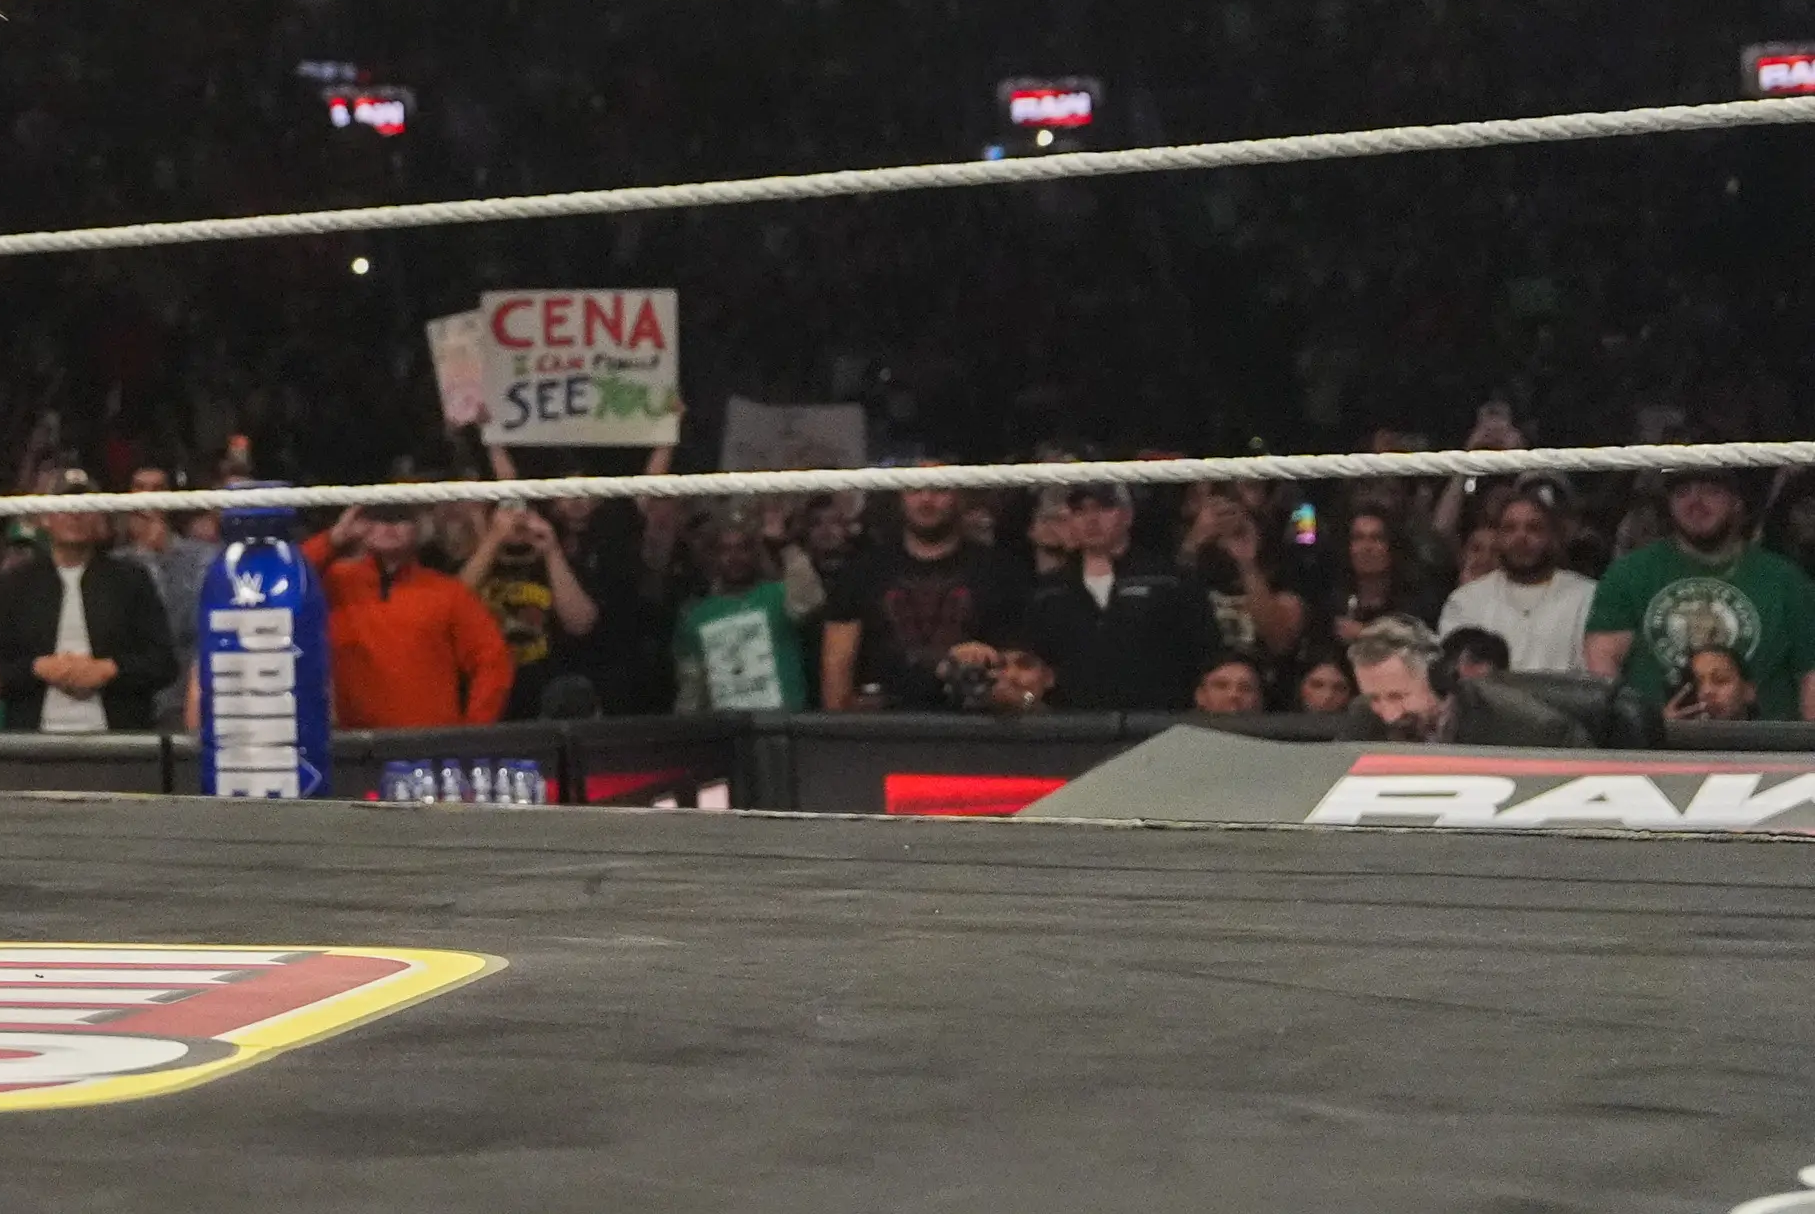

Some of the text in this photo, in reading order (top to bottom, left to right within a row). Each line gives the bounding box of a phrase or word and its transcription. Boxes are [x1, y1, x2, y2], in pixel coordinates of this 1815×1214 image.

[491, 295, 666, 349] CENA
[502, 374, 592, 430] SEE
[209, 607, 300, 798] PRIME
